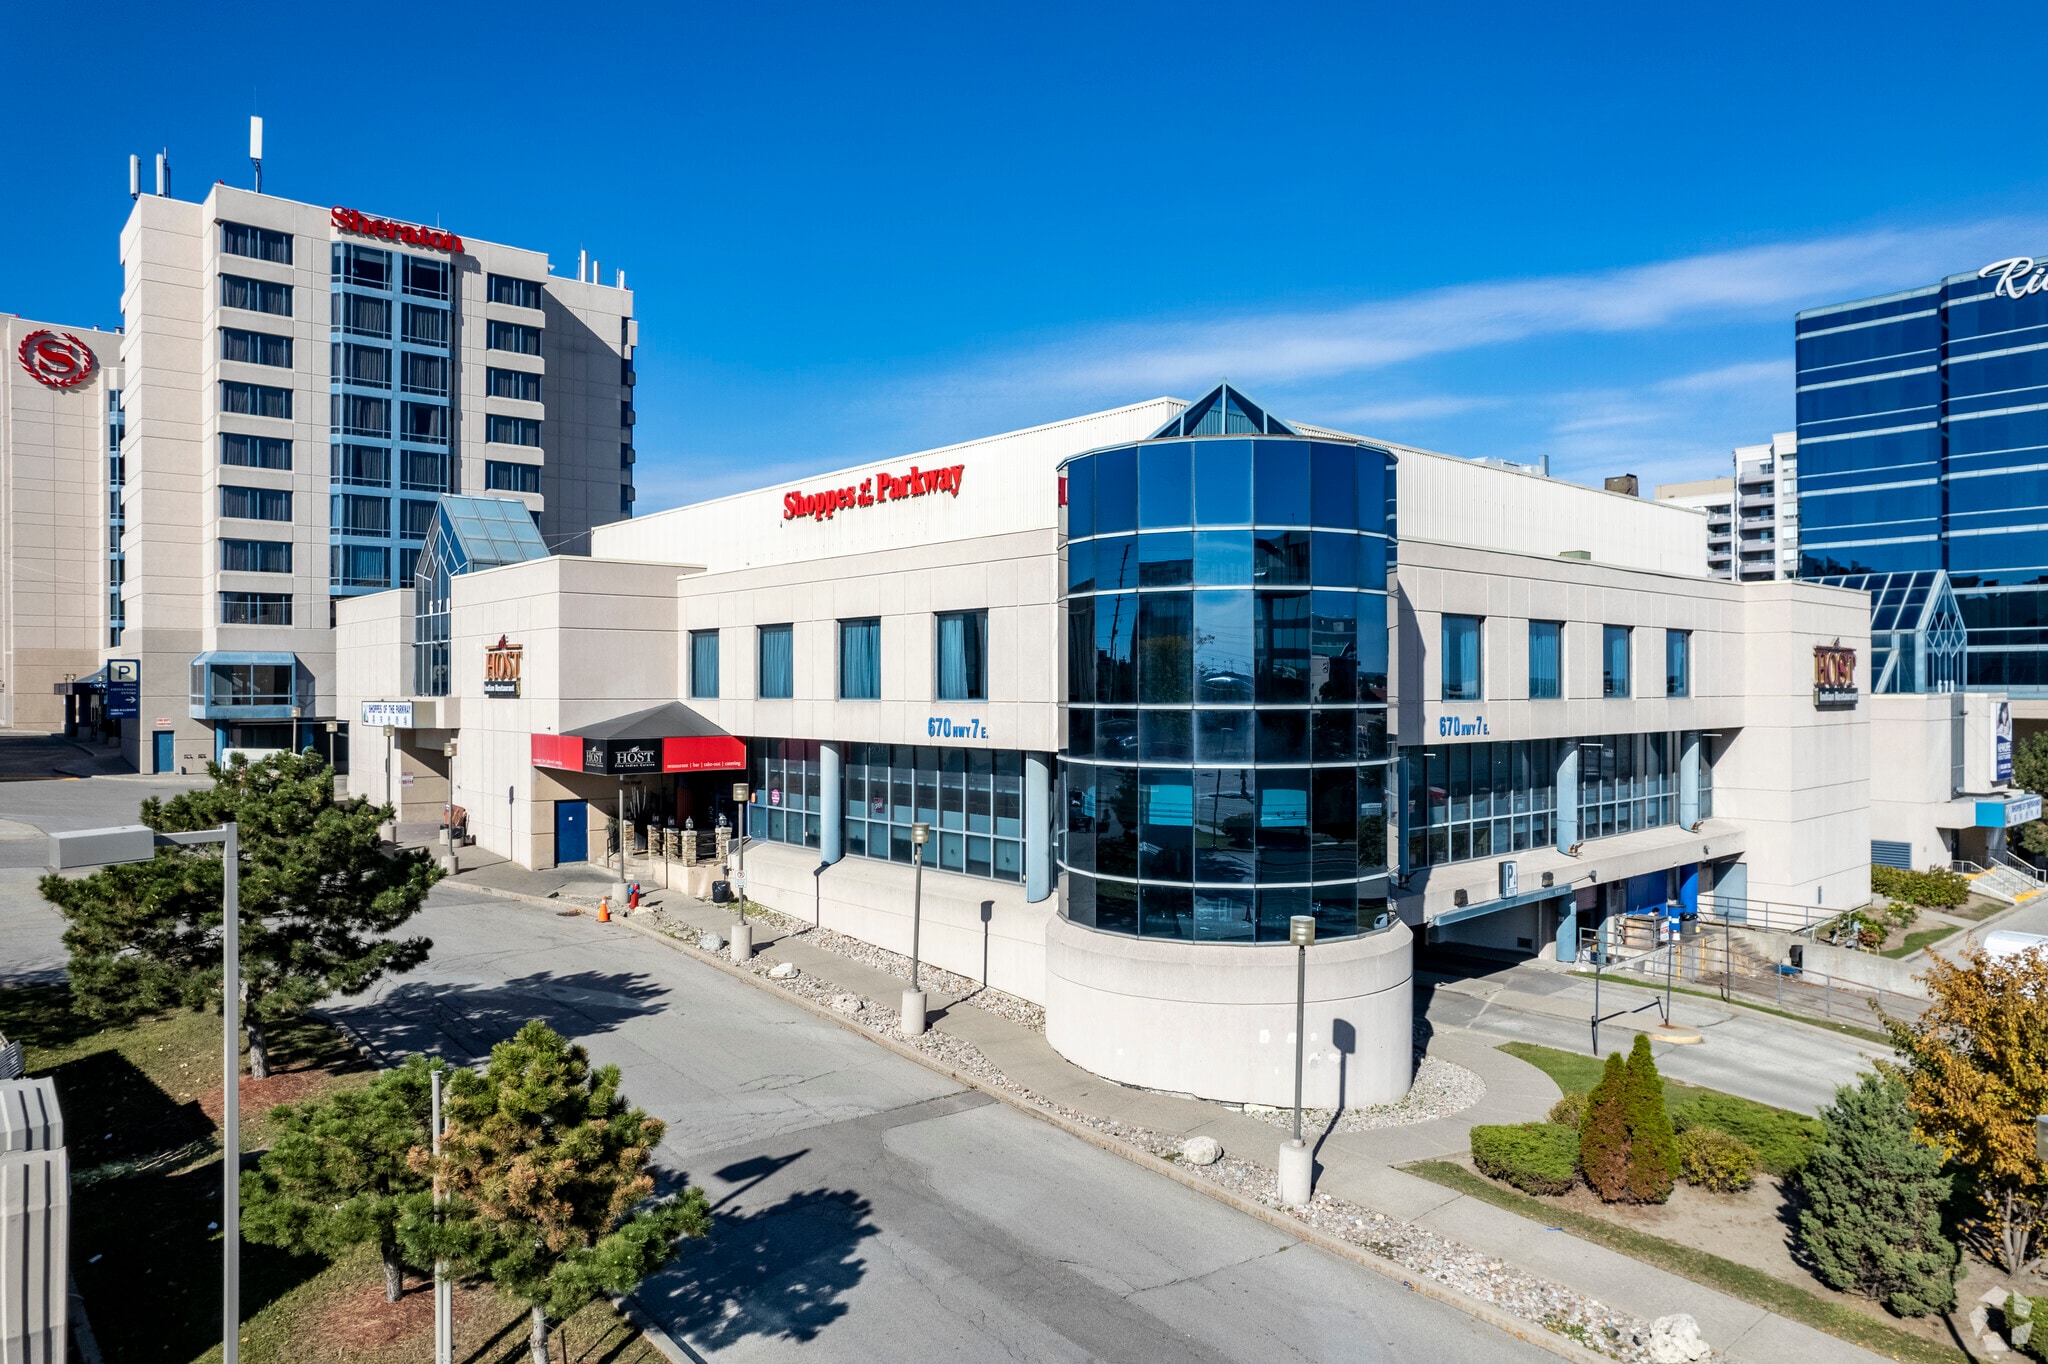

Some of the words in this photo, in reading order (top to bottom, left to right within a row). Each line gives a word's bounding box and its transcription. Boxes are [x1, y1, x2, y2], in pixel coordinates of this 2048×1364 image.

[331, 205, 463, 252] Sheraton
[1978, 256, 2048, 299] Ri
[38, 340, 75, 374] S
[859, 477, 872, 493] of
[876, 464, 965, 502] Parkway
[784, 486, 857, 521] Shoppes
[857, 493, 875, 508] the
[118, 666, 131, 680] P
[485, 651, 522, 680] HOST
[1814, 651, 1856, 687] HOST
[495, 684, 515, 692] Restaurant
[1819, 691, 1834, 701] Indian
[1834, 691, 1858, 701] Restaurant
[928, 717, 951, 738] 670
[952, 726, 971, 738] HWY
[971, 718, 979, 738] 7
[1440, 716, 1460, 737] 670
[1461, 724, 1476, 735] HWY
[1476, 715, 1482, 735] 7
[586, 751, 603, 763] HOST
[615, 751, 655, 764] HOST
[1507, 864, 1514, 887] P
